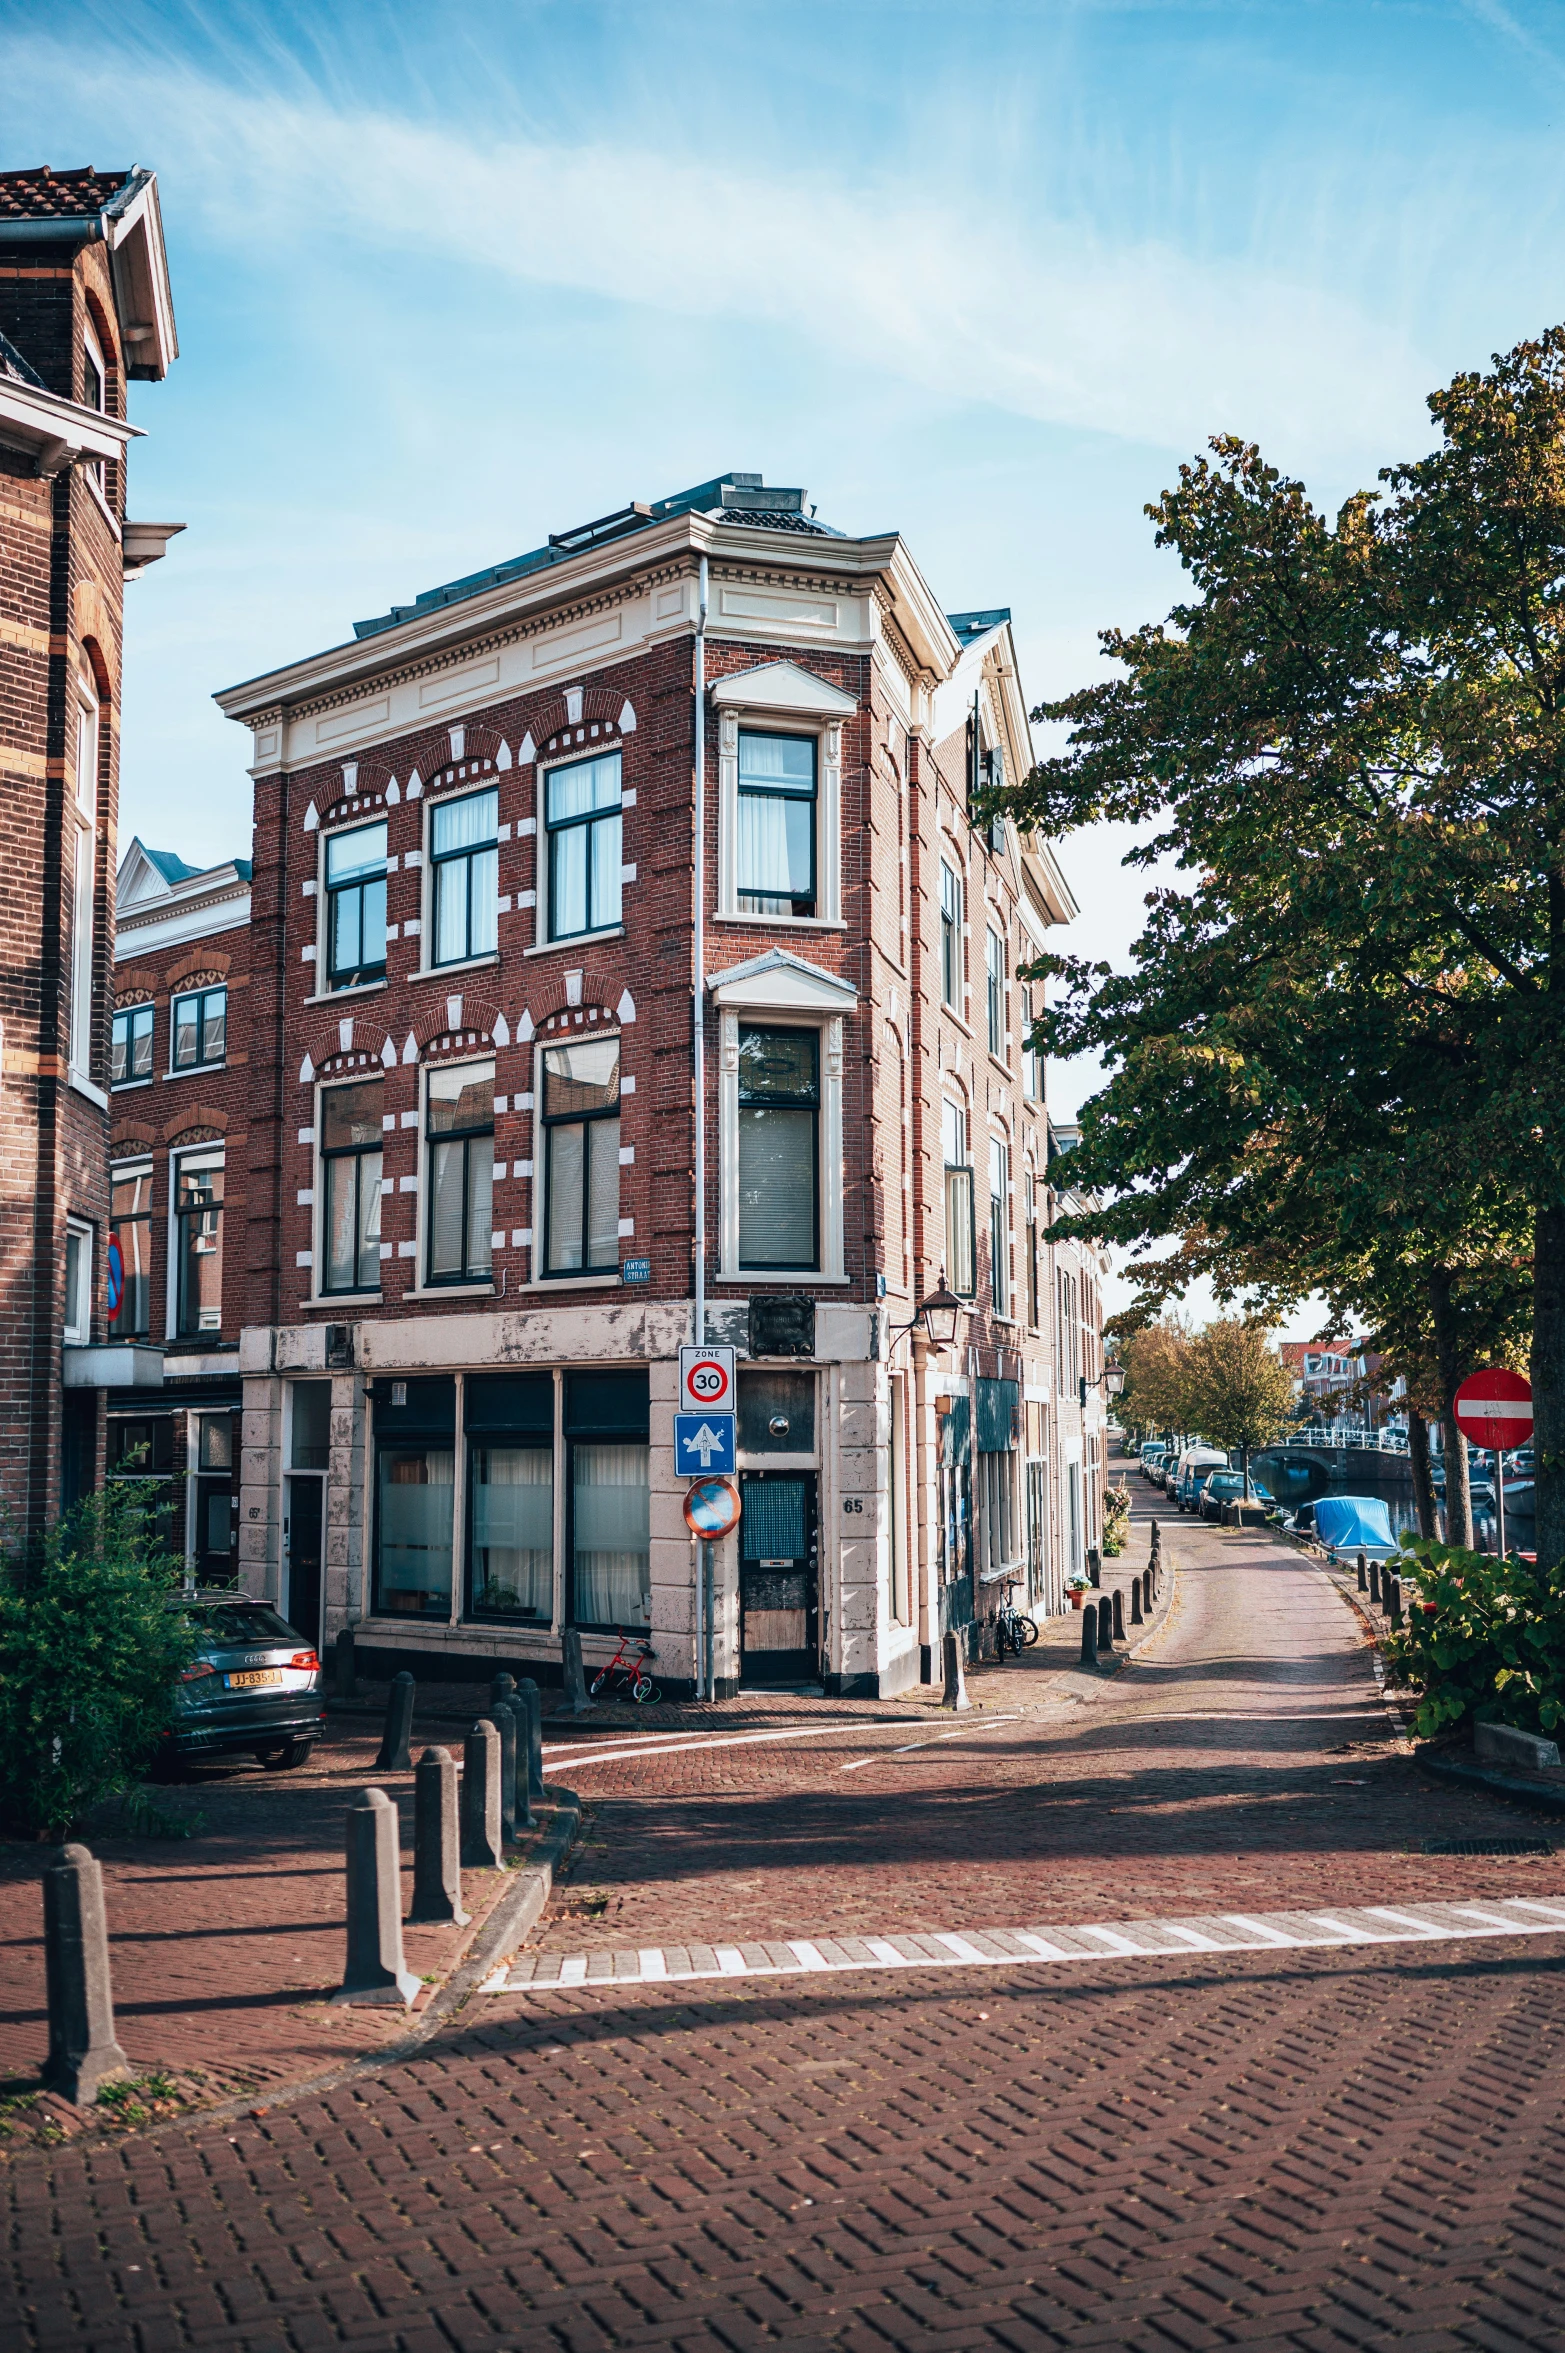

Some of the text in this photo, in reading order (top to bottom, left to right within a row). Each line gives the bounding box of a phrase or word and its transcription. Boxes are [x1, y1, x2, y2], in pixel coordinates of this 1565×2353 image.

[627, 1271, 650, 1280] STRAAT
[695, 1374, 720, 1390] 30
[843, 1499, 863, 1514] 65
